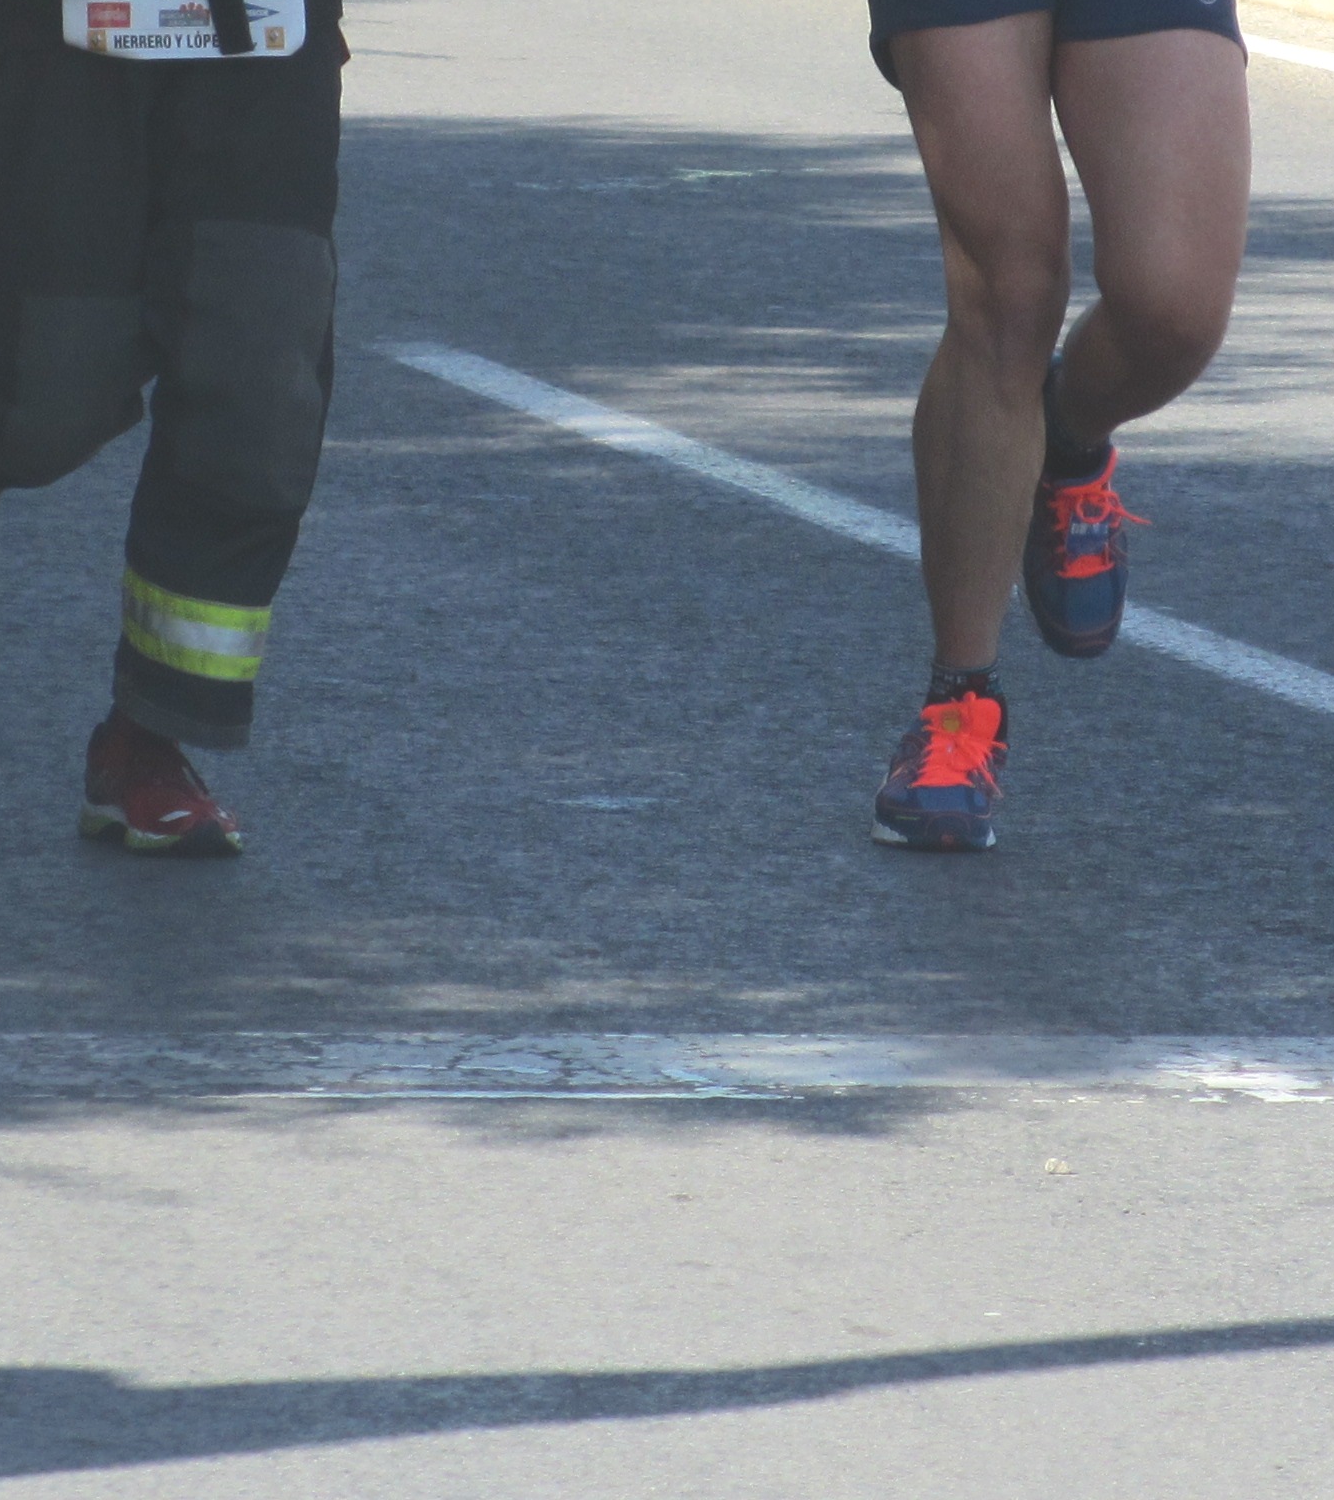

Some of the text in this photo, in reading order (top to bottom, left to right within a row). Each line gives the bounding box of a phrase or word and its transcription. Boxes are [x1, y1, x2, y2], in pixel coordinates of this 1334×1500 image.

[114, 31, 220, 49] HERRERO Y LÓPE
